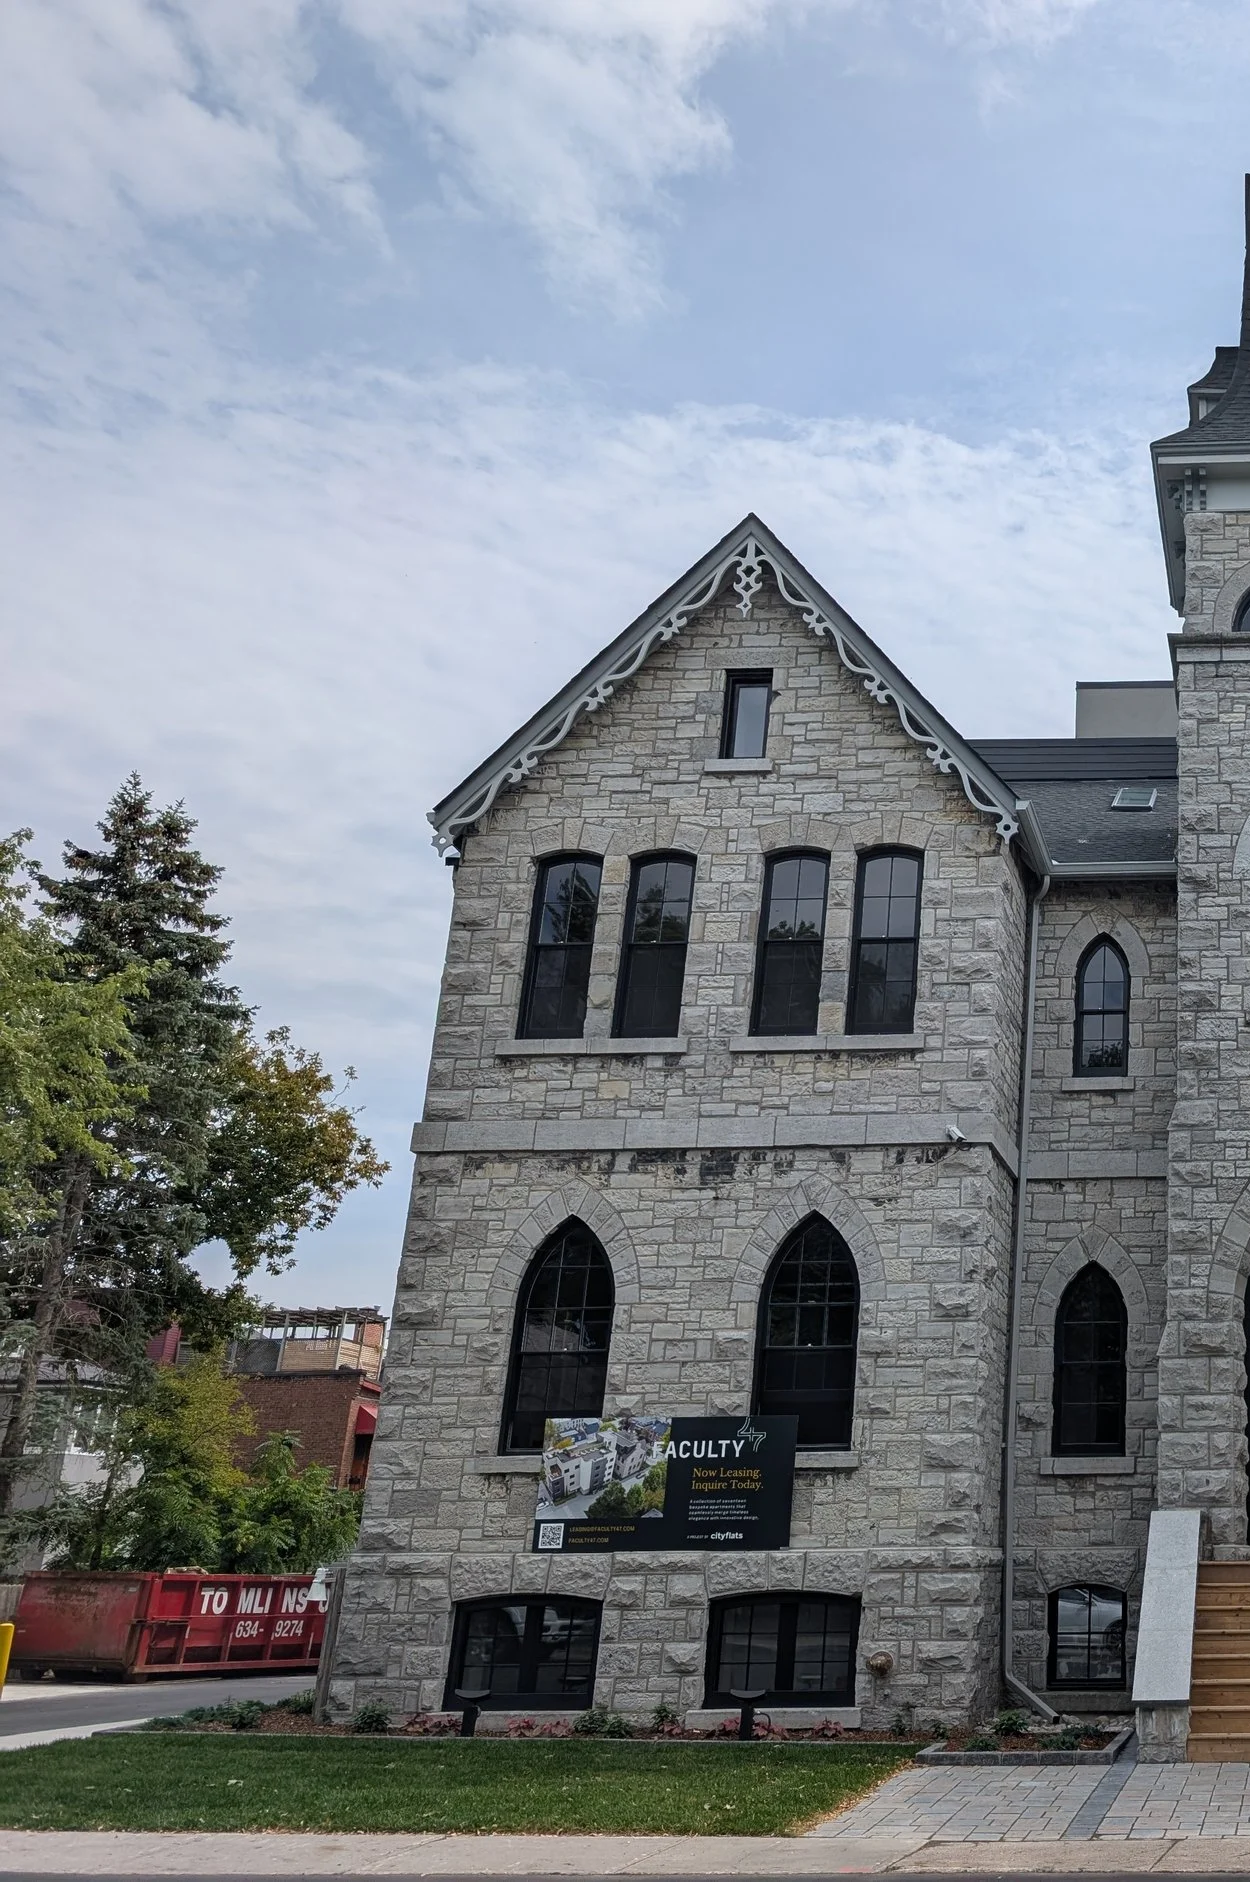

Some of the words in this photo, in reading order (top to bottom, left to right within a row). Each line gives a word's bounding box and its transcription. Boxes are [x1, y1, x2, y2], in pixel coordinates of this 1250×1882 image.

[652, 1439, 745, 1459] FACULTY
[693, 1467, 717, 1478] Now
[720, 1467, 762, 1480] Leasing.
[691, 1480, 727, 1492] Inquire
[730, 1480, 764, 1492] Today.
[710, 1531, 743, 1541] cityflats
[274, 1620, 304, 1637] 9274
